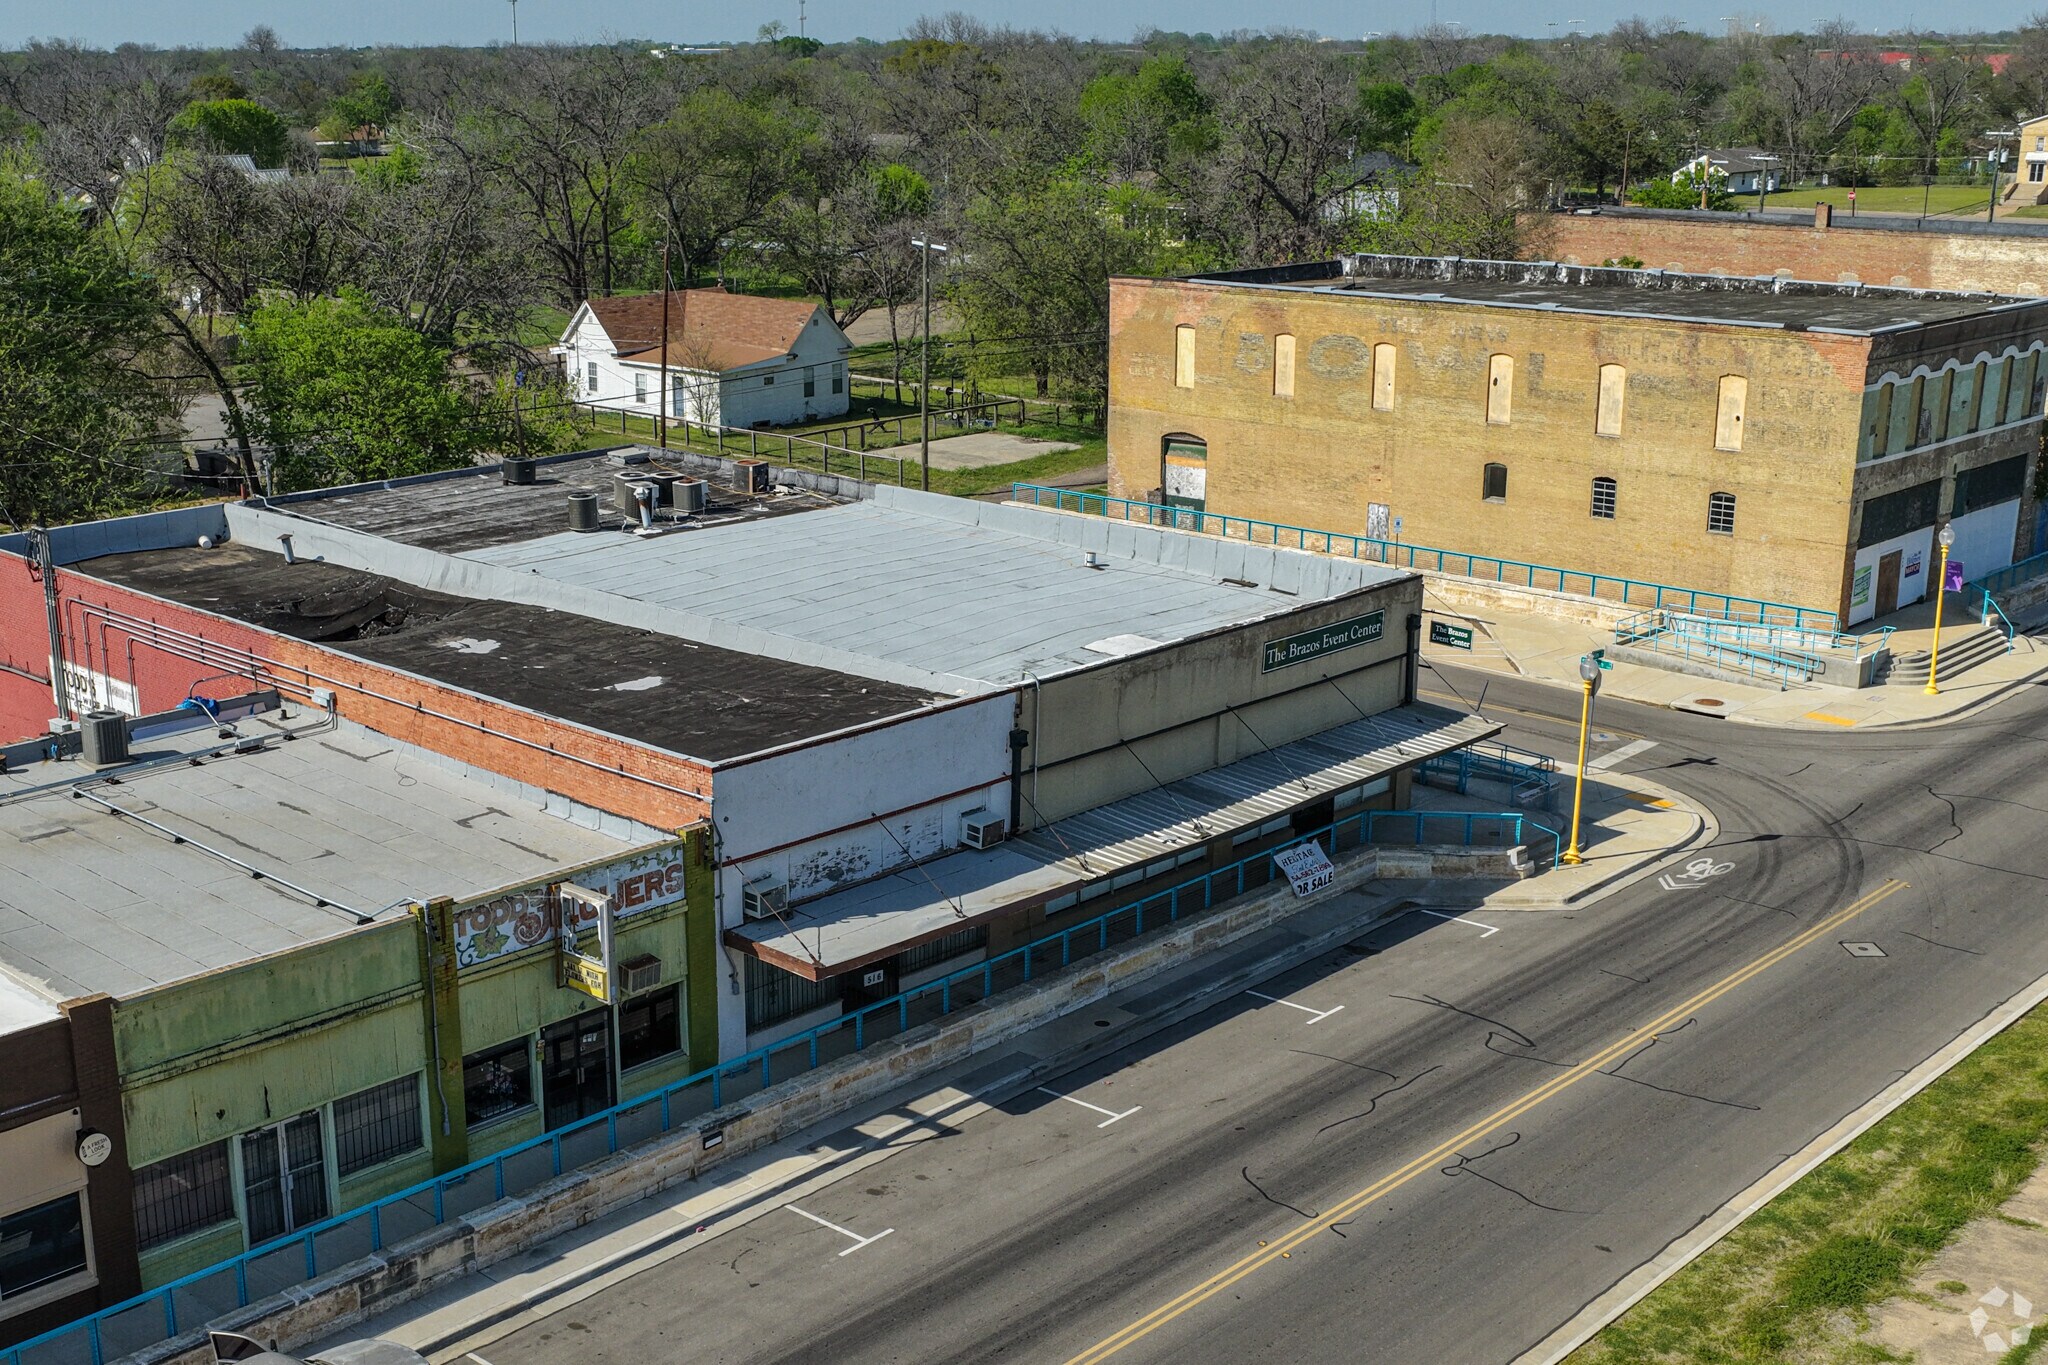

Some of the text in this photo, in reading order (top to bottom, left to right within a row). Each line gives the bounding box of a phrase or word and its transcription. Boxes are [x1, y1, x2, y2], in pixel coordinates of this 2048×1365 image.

[1435, 624, 1468, 638] The Brazos
[1267, 622, 1382, 665] The Brazos Event Center
[1432, 633, 1471, 648] Event Center
[1297, 871, 1333, 894] OR SALE
[867, 973, 882, 984] 516
[91, 1137, 107, 1147] FRESH
[91, 1144, 105, 1154] LOOK
